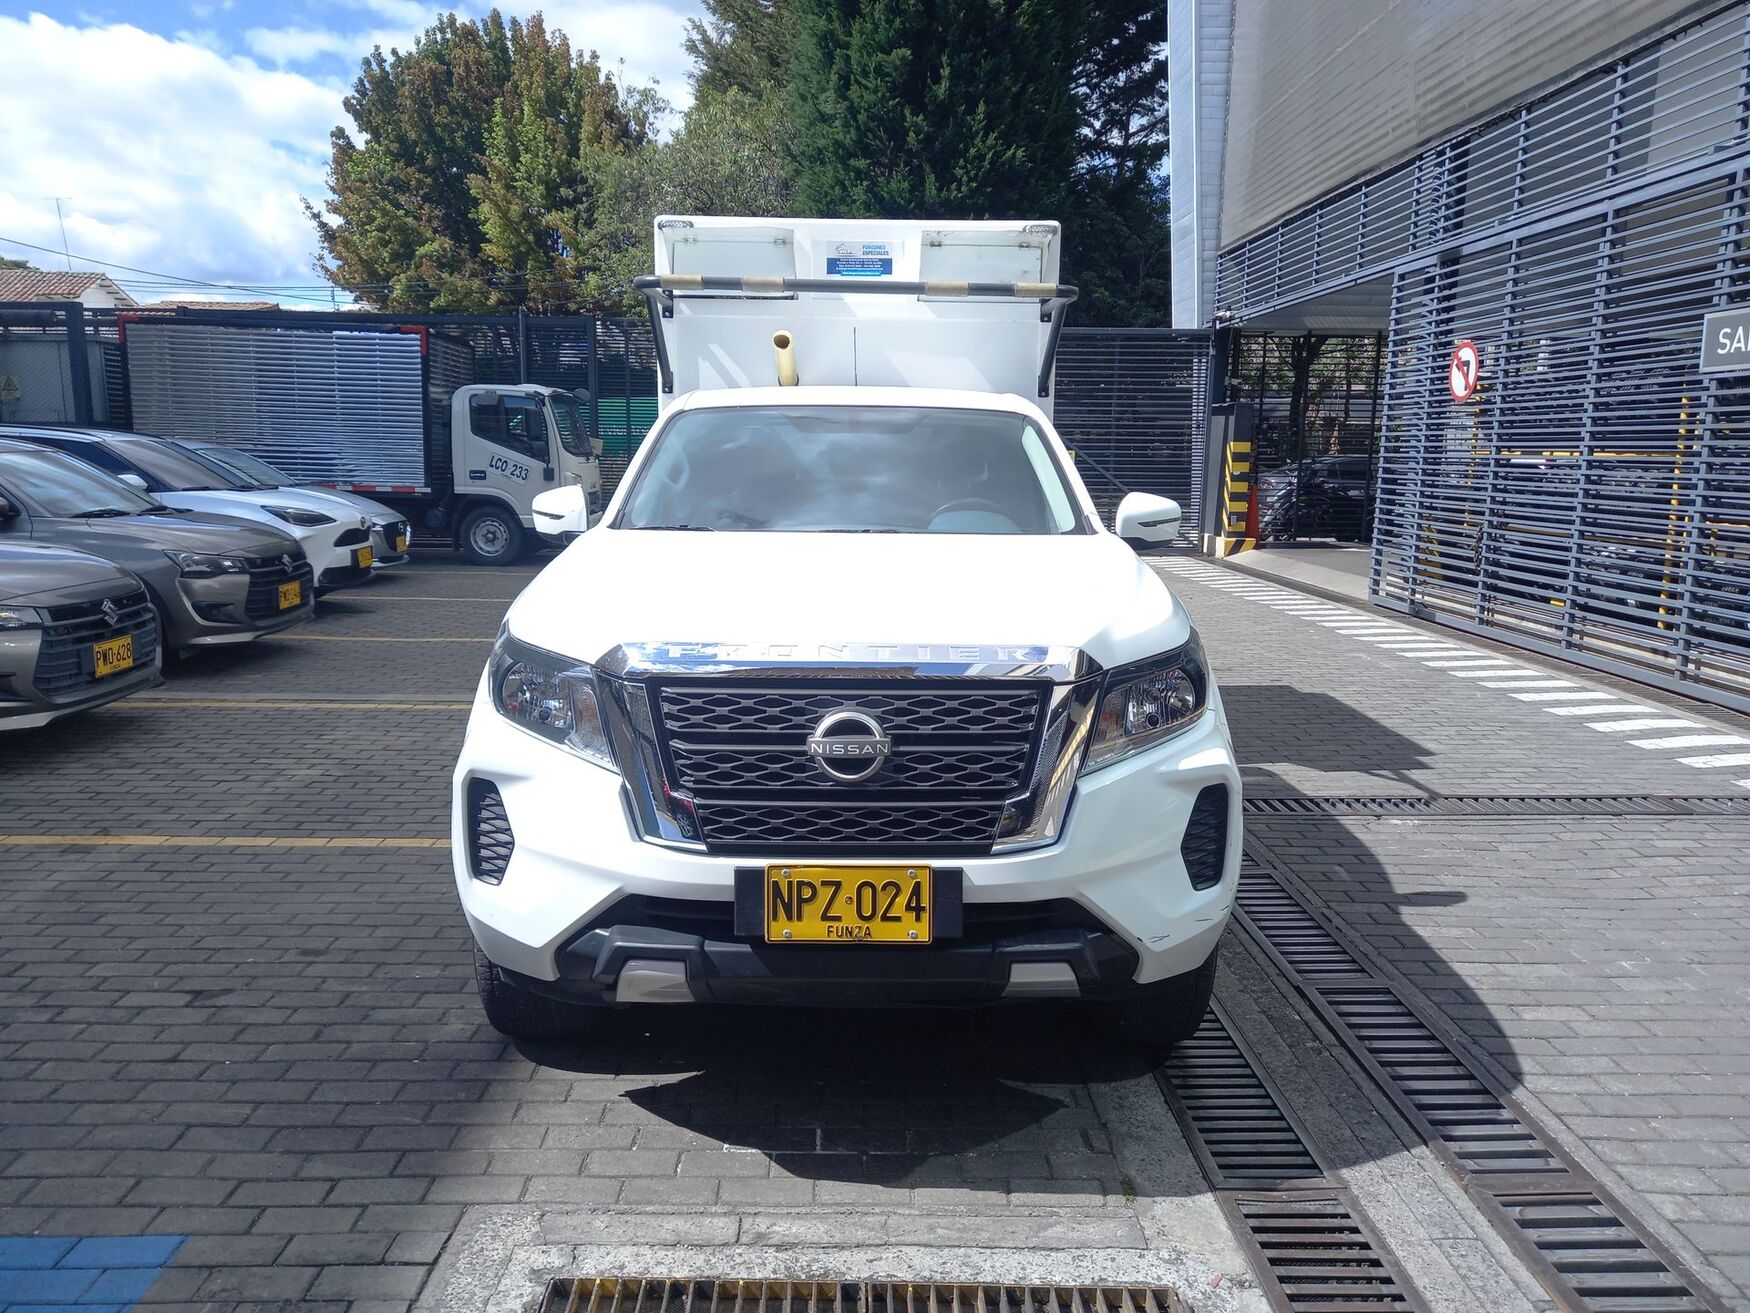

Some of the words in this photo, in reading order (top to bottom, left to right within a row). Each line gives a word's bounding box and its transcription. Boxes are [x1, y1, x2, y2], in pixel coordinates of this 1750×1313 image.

[1717, 325, 1750, 355] SA
[489, 455, 509, 472] LCO
[510, 464, 529, 481] 233
[666, 645, 1034, 660] FRONTIER
[811, 743, 889, 755] NISSAN
[826, 925, 873, 939] FUNZA
